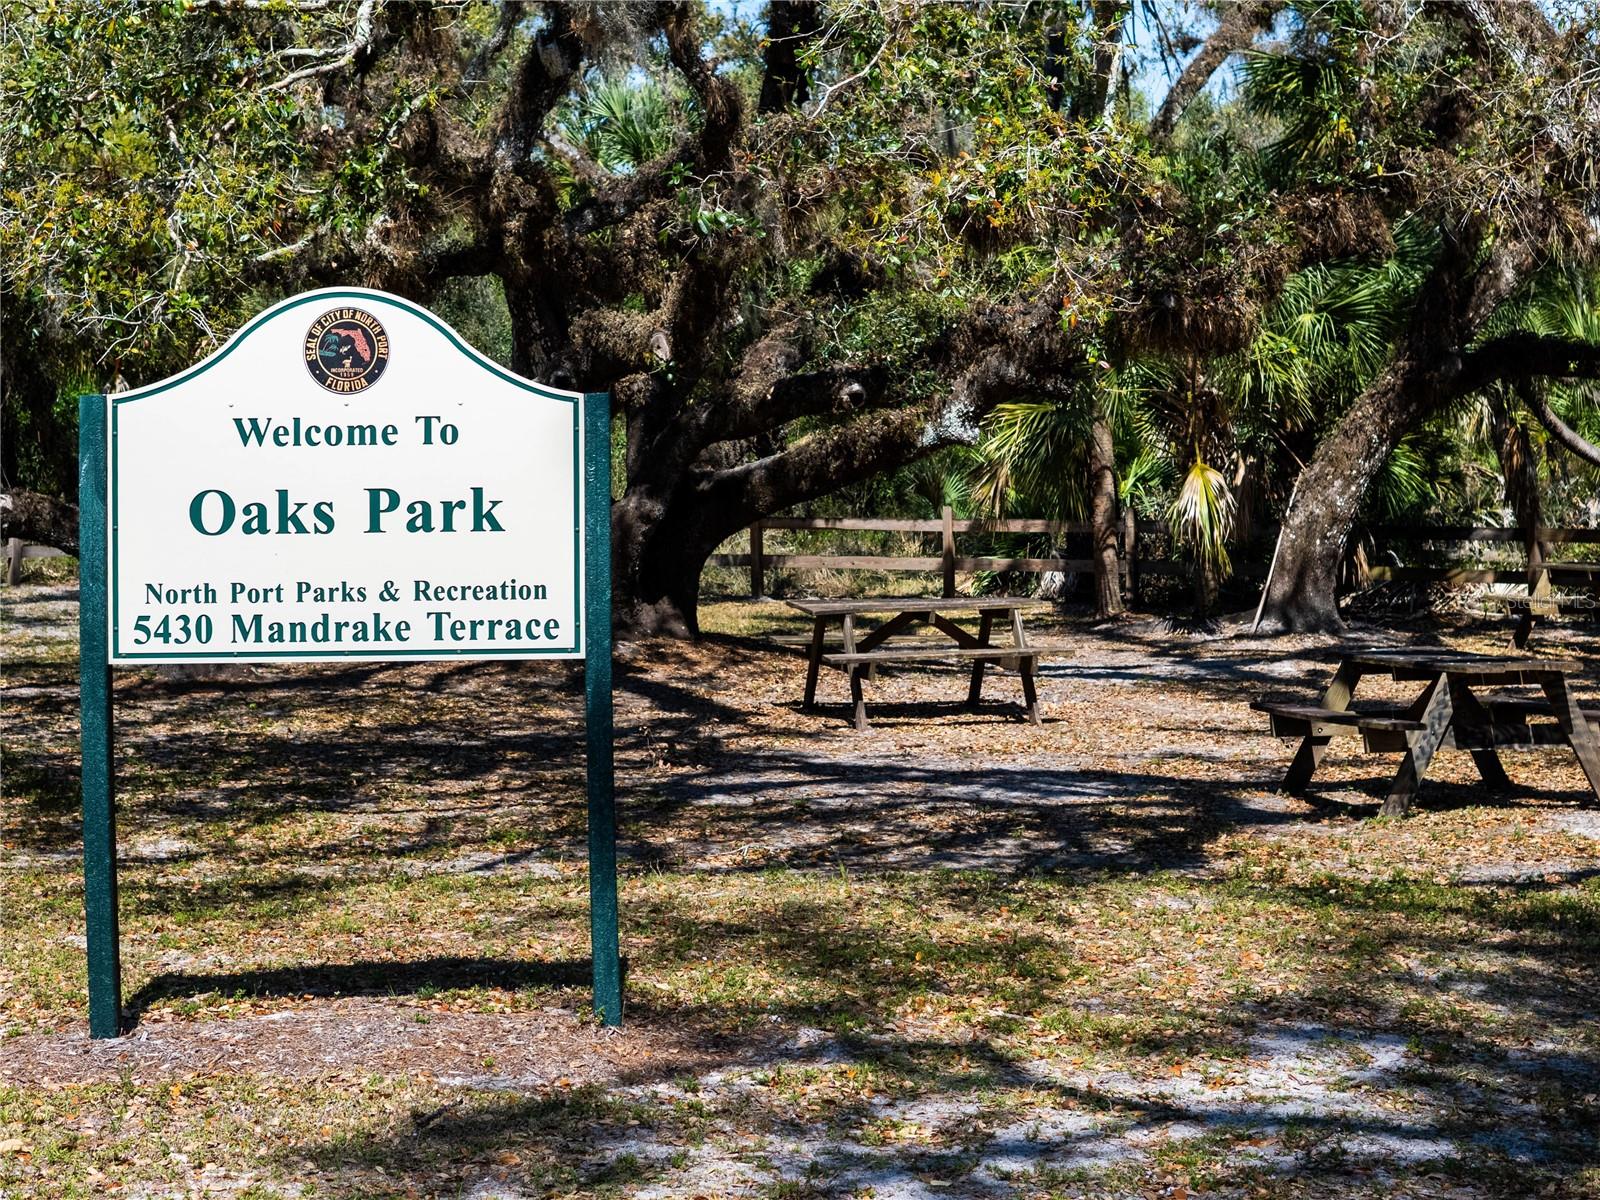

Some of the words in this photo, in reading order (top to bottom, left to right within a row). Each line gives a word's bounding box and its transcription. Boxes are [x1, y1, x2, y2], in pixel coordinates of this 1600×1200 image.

[321, 310, 341, 326] CITY
[342, 309, 354, 318] OF
[355, 311, 382, 334] NORTH
[311, 325, 323, 336] OF
[306, 338, 317, 361] SEAL
[377, 336, 389, 360] PORT
[325, 377, 368, 391] FLORIDA
[233, 418, 398, 447] Welcome
[415, 416, 458, 445] To
[190, 490, 334, 535] Oaks
[364, 487, 505, 533] Park
[145, 583, 217, 604] North
[231, 583, 284, 603] Port
[296, 581, 366, 602] Parks
[379, 581, 400, 602] &
[414, 579, 547, 601] Recreation
[134, 615, 212, 644] 5430
[232, 612, 410, 643] Mandrake
[427, 612, 560, 641] Terrace
